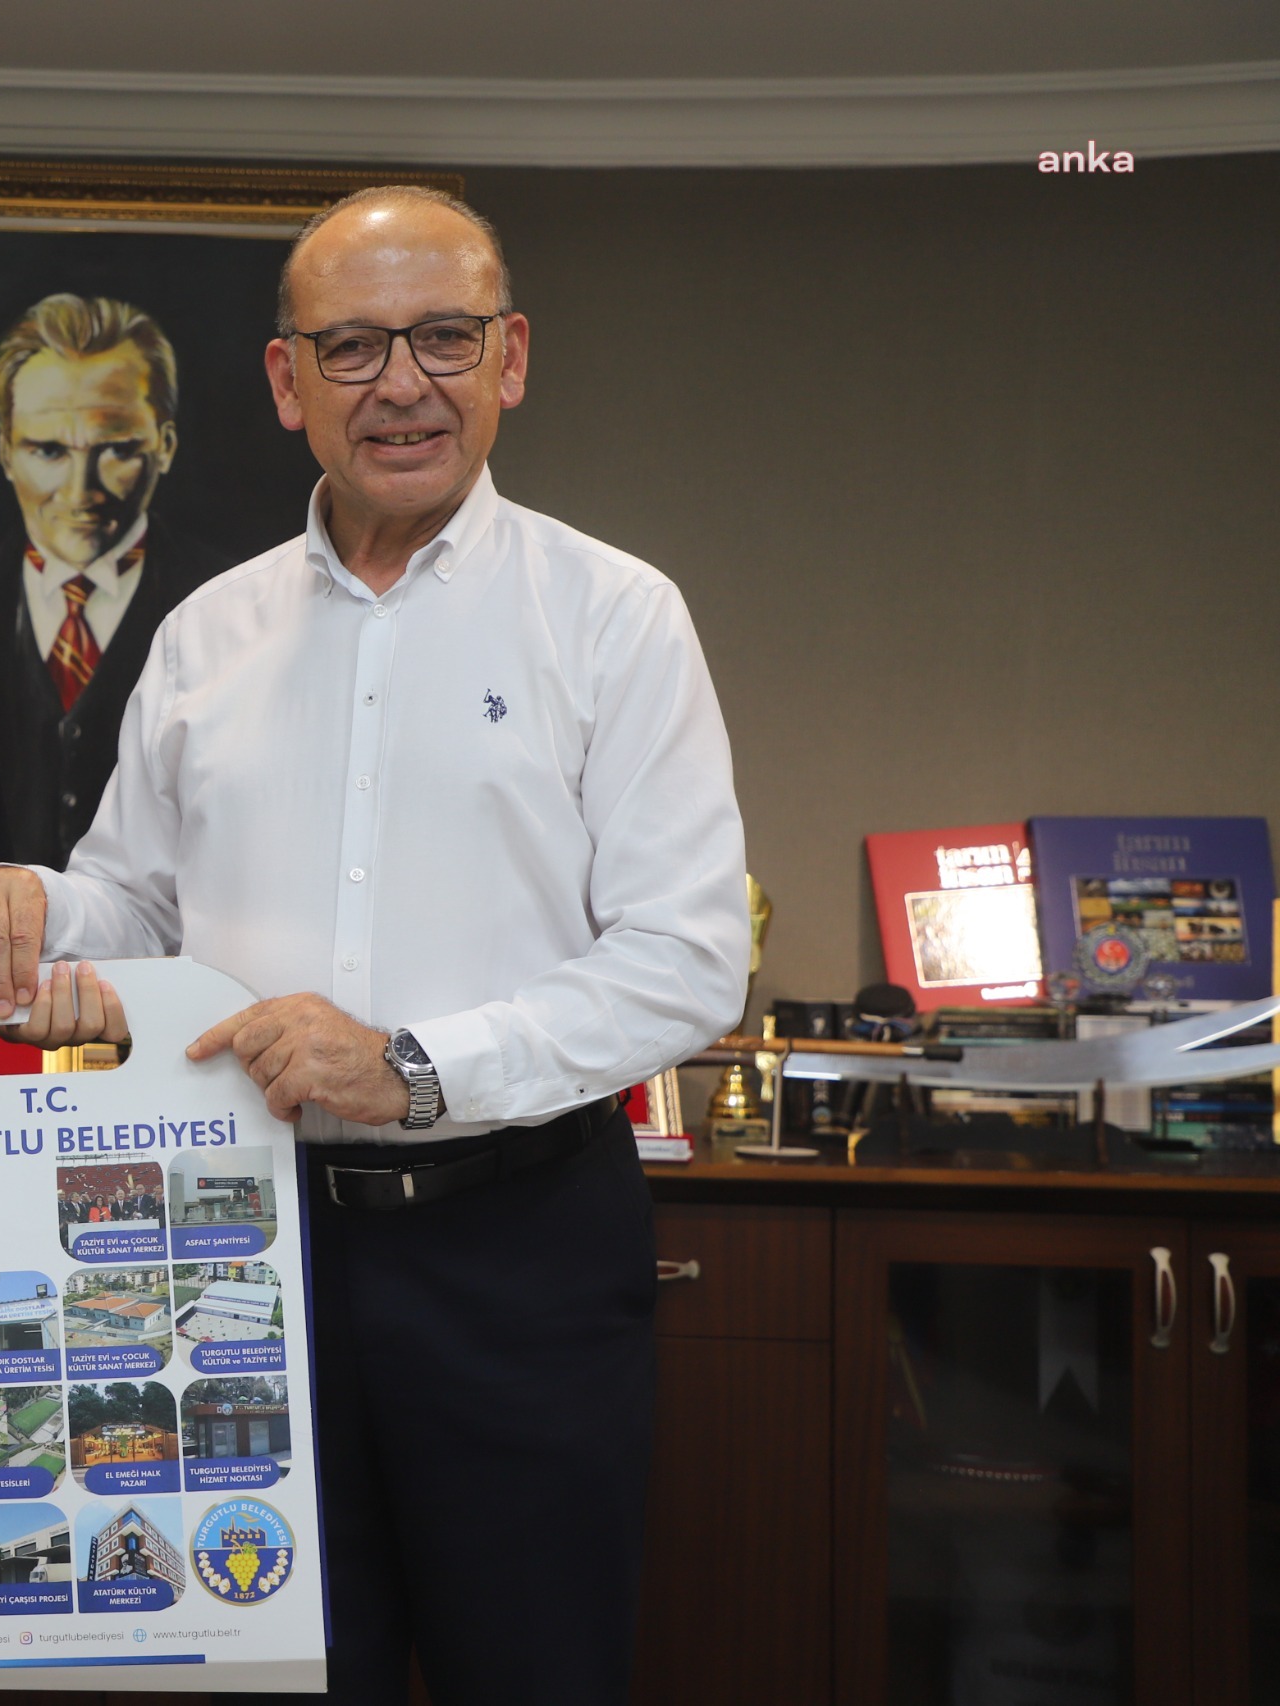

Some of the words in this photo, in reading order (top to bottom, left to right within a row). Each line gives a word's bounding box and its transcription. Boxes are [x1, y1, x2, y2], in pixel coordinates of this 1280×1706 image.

[20, 1086, 78, 1113] T.C.
[57, 1112, 237, 1153] BELEDİYESİ
[80, 1237, 105, 1246] TAZİYE
[106, 1237, 119, 1245] EVİ
[130, 1236, 158, 1246] ÇOCUK
[185, 1238, 211, 1246] ASFALT
[212, 1236, 250, 1247] ŞANTİYESİ
[77, 1246, 105, 1256] KÜLTÜR
[107, 1246, 131, 1254] SANAT
[133, 1243, 165, 1253] MERKEZİ
[200, 1348, 240, 1357] TURGUTLU
[242, 1344, 282, 1355] BELEDİYESİ
[11, 1356, 45, 1365] DOSTLAR
[71, 1353, 96, 1363] TAZİYE
[98, 1352, 110, 1361] EVİ
[121, 1352, 150, 1362] ÇOCUK
[202, 1356, 231, 1366] KÜLTÜR
[242, 1355, 267, 1364] TAZİYE
[269, 1353, 281, 1363] EVİ
[4, 1364, 32, 1374] ÜRETİM
[33, 1363, 55, 1372] TESİSİ
[68, 1362, 96, 1372] KÜLTÜR
[98, 1362, 123, 1371] SANAT
[124, 1359, 156, 1369] MERKEZİ
[105, 1471, 114, 1479] EL
[115, 1469, 139, 1479] EMEĞİ
[141, 1469, 161, 1478] HALK
[189, 1466, 230, 1475] TURGUTLU
[231, 1463, 272, 1473] BELEDİYESİ
[120, 1479, 147, 1487] PAZARI
[199, 1475, 228, 1484] HİZMET
[229, 1474, 263, 1482] NOKTASI
[197, 1503, 237, 1548] TURGUTLU
[241, 1503, 289, 1545] BELEDİYESİ
[93, 1587, 126, 1596] ATATÜRK
[128, 1586, 157, 1595] KÜLTÜR
[233, 1591, 255, 1599] 1872
[8, 1595, 37, 1605] ÇARŞISI
[39, 1593, 68, 1602] PROJESİ
[109, 1595, 141, 1605] MERKEZİ
[39, 1631, 124, 1644] turgutlubelediyesi
[153, 1628, 241, 1640] www.turgutlu.bel.tr
